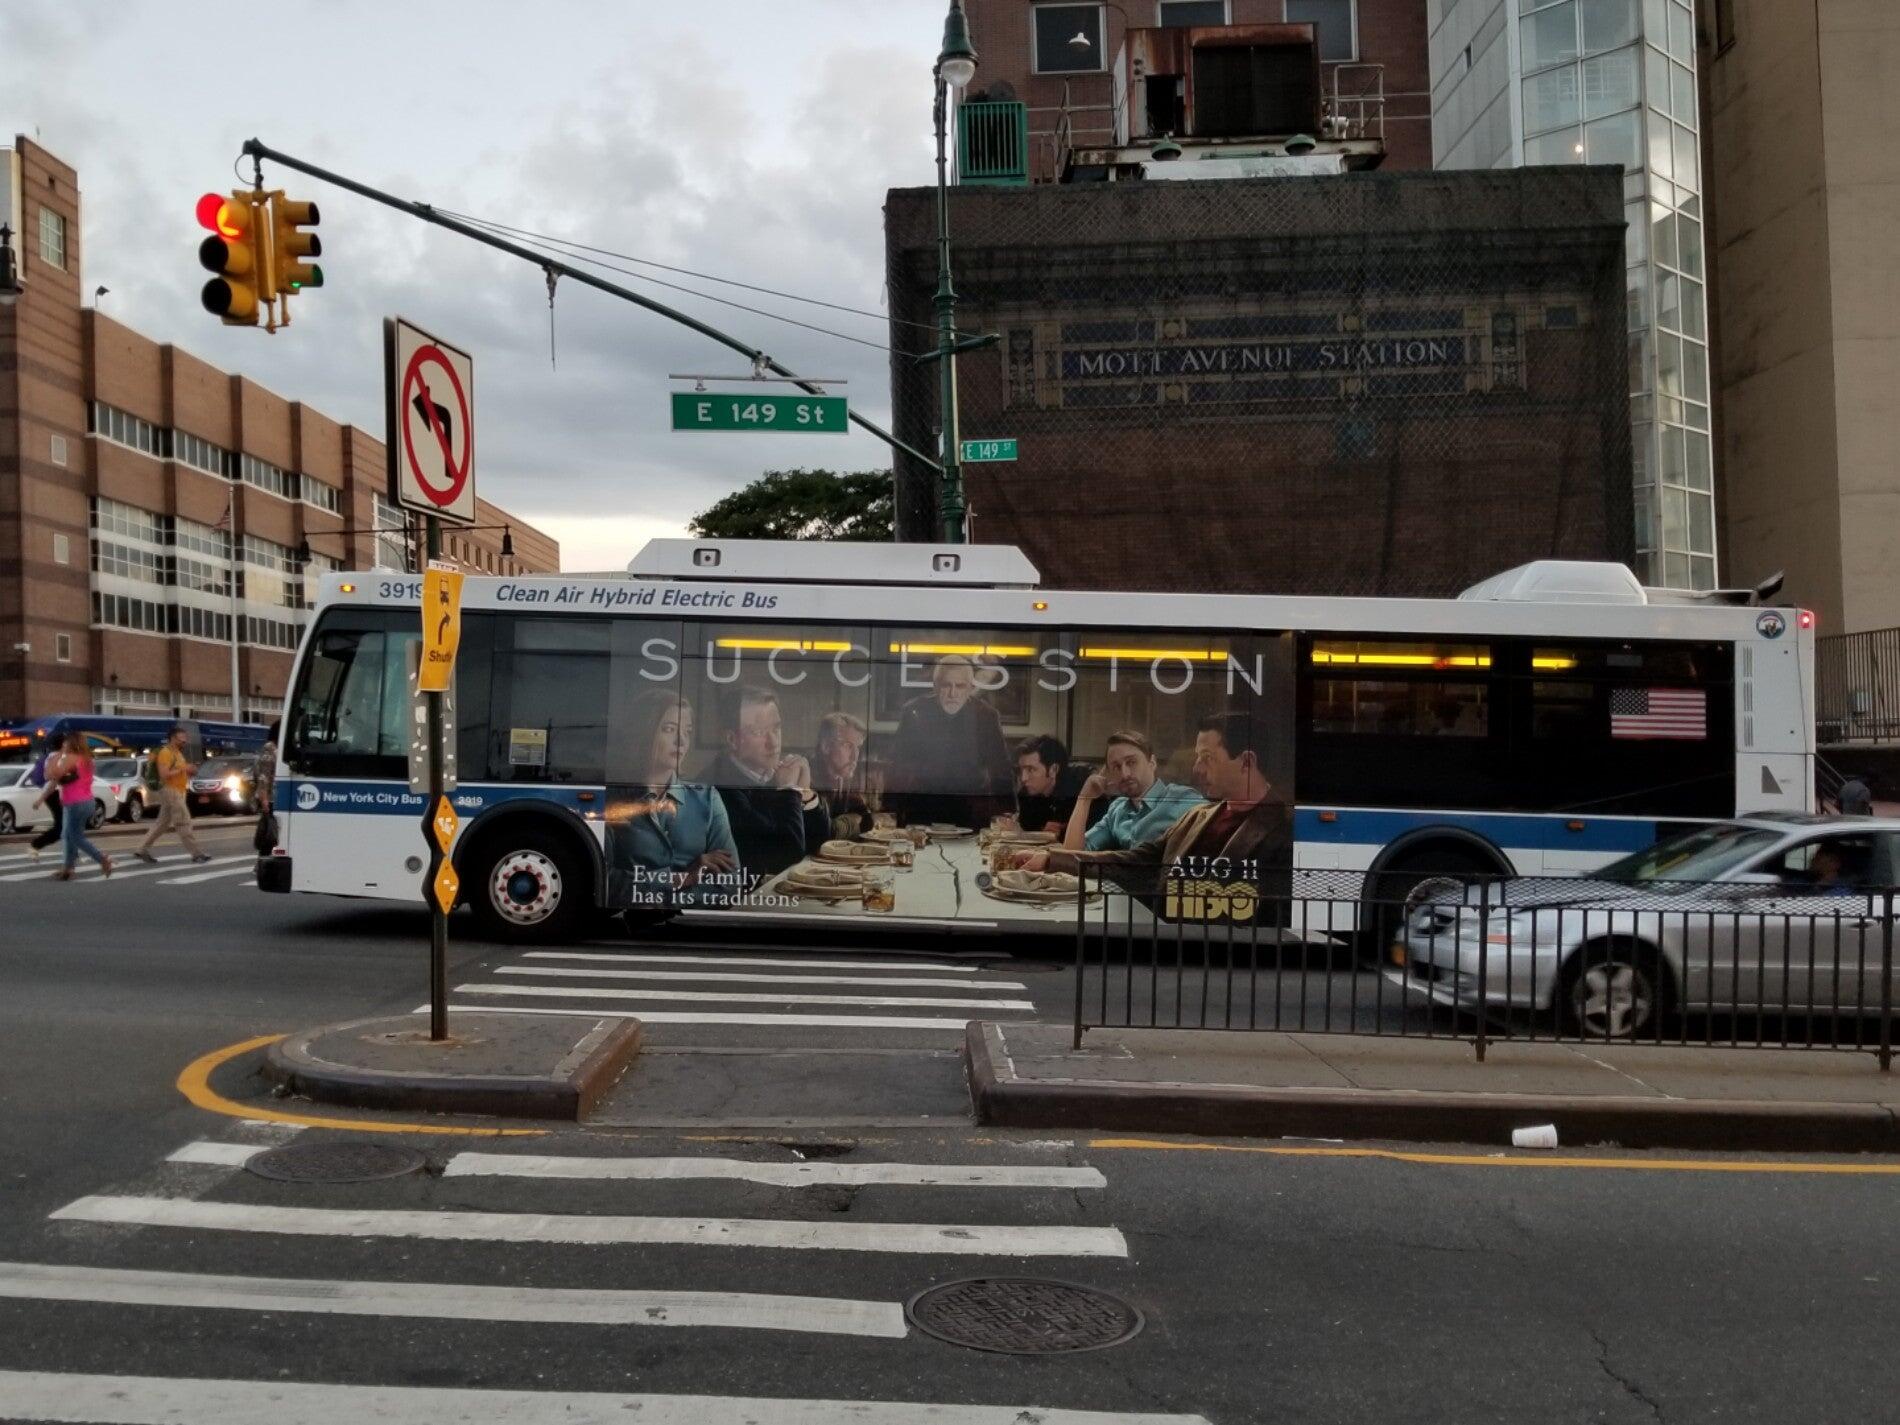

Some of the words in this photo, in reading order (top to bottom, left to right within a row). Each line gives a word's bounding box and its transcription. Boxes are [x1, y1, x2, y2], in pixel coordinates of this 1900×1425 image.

[697, 402, 713, 422] E
[731, 402, 777, 424] 149
[795, 404, 825, 425] St
[966, 444, 973, 459] E
[979, 443, 999, 459] 149
[496, 584, 549, 604] Clean
[553, 586, 586, 605] Air
[589, 587, 655, 608] Hybrid
[660, 589, 736, 608] Electric
[741, 591, 778, 610] Bus
[638, 636, 1265, 697] SUCCESSION
[323, 792, 348, 803] New
[350, 793, 374, 804] York
[375, 794, 399, 807] City
[401, 796, 423, 805] Bus
[458, 796, 484, 807] 3919
[633, 865, 689, 889] Every
[697, 866, 761, 891] family
[1167, 855, 1232, 878] AUG
[1241, 858, 1258, 880] 11
[632, 885, 664, 904] has
[671, 887, 695, 906] its
[702, 888, 800, 908] traditions
[1165, 879, 1260, 920] HBO
